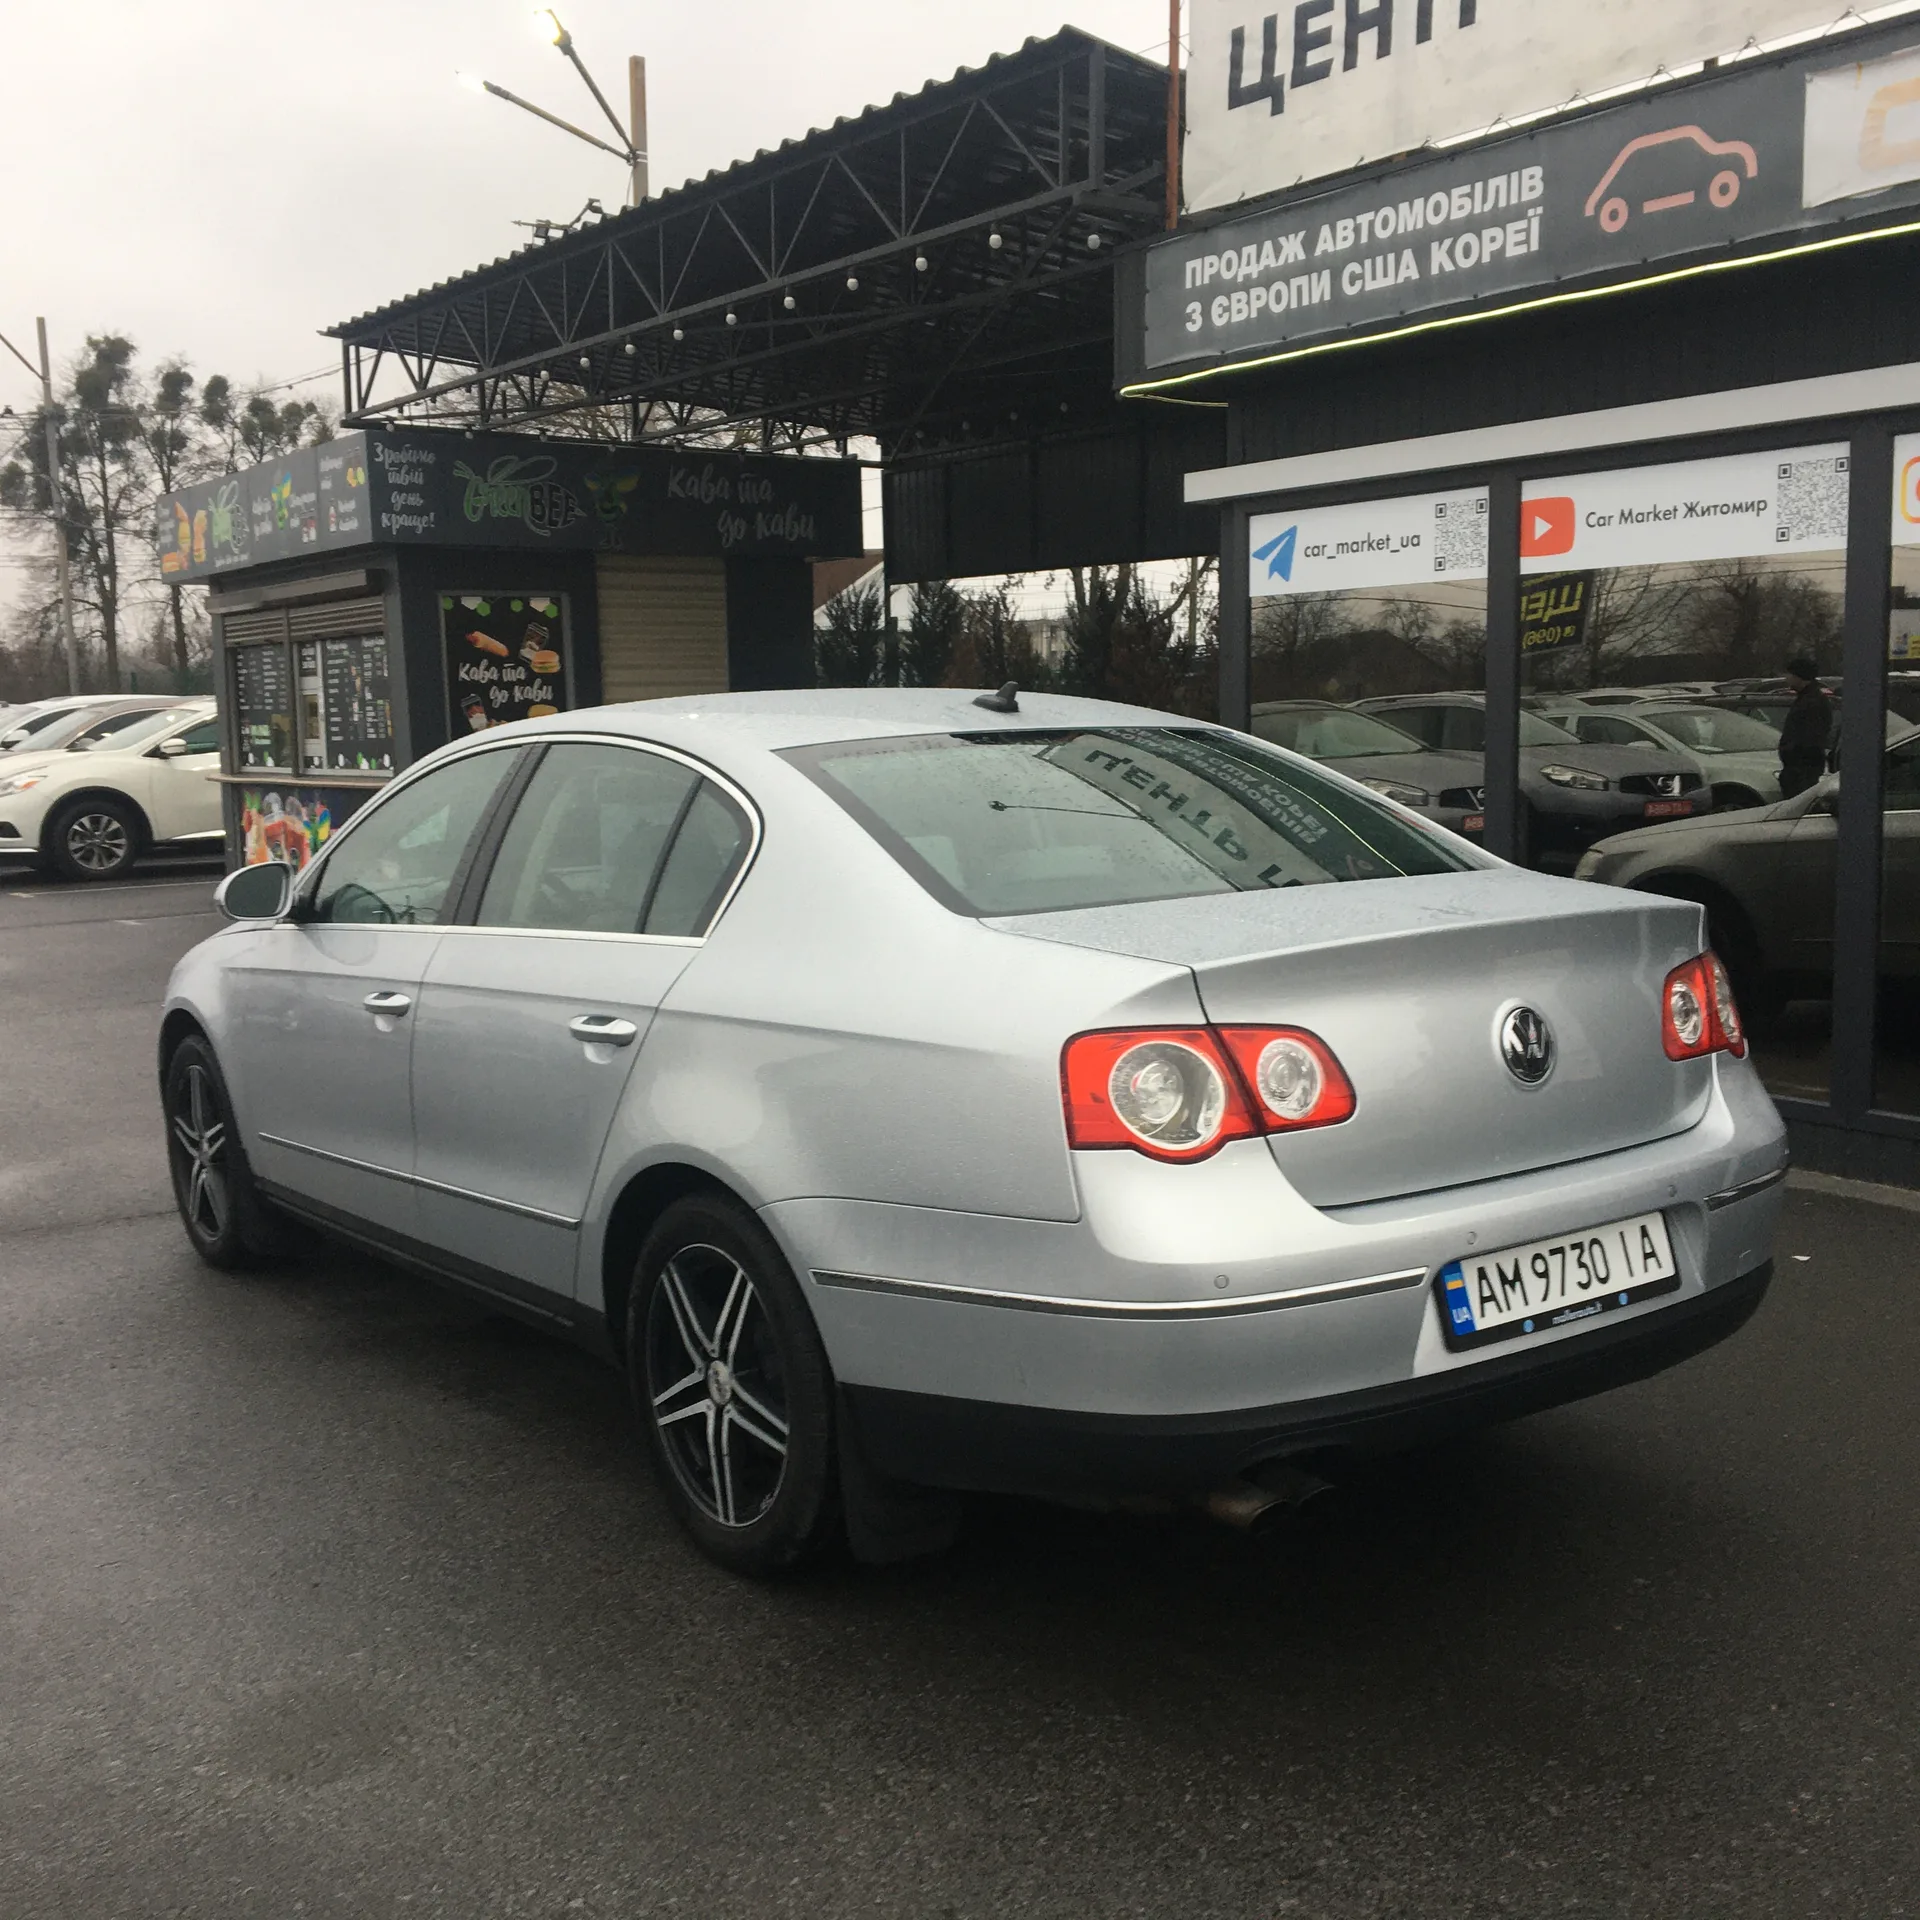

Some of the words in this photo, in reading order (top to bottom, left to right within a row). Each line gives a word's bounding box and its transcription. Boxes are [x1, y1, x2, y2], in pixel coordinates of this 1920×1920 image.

[1228, 0, 1476, 117] ЦЕН
[1184, 230, 1306, 289] ПРОДАЖ
[1314, 165, 1544, 256] АВТОМОБІЛІВ
[1184, 301, 1203, 332] З
[1210, 269, 1331, 327] ЄВРОПИ
[1341, 248, 1420, 296] США
[1430, 206, 1544, 275] КОРЕЇ
[665, 463, 729, 503] Кава
[380, 511, 436, 536] краще!
[756, 502, 815, 542] кави
[1585, 511, 1615, 528] Car
[1618, 503, 1679, 525] Market
[1683, 498, 1768, 521] Житомир
[1303, 531, 1422, 560] car_market_ua
[458, 658, 499, 684] Кава
[513, 678, 553, 702] кави
[1476, 1257, 1529, 1318] AM
[1531, 1237, 1610, 1303] 9730
[1618, 1224, 1662, 1278] IA
[1452, 1308, 1472, 1324] UA
